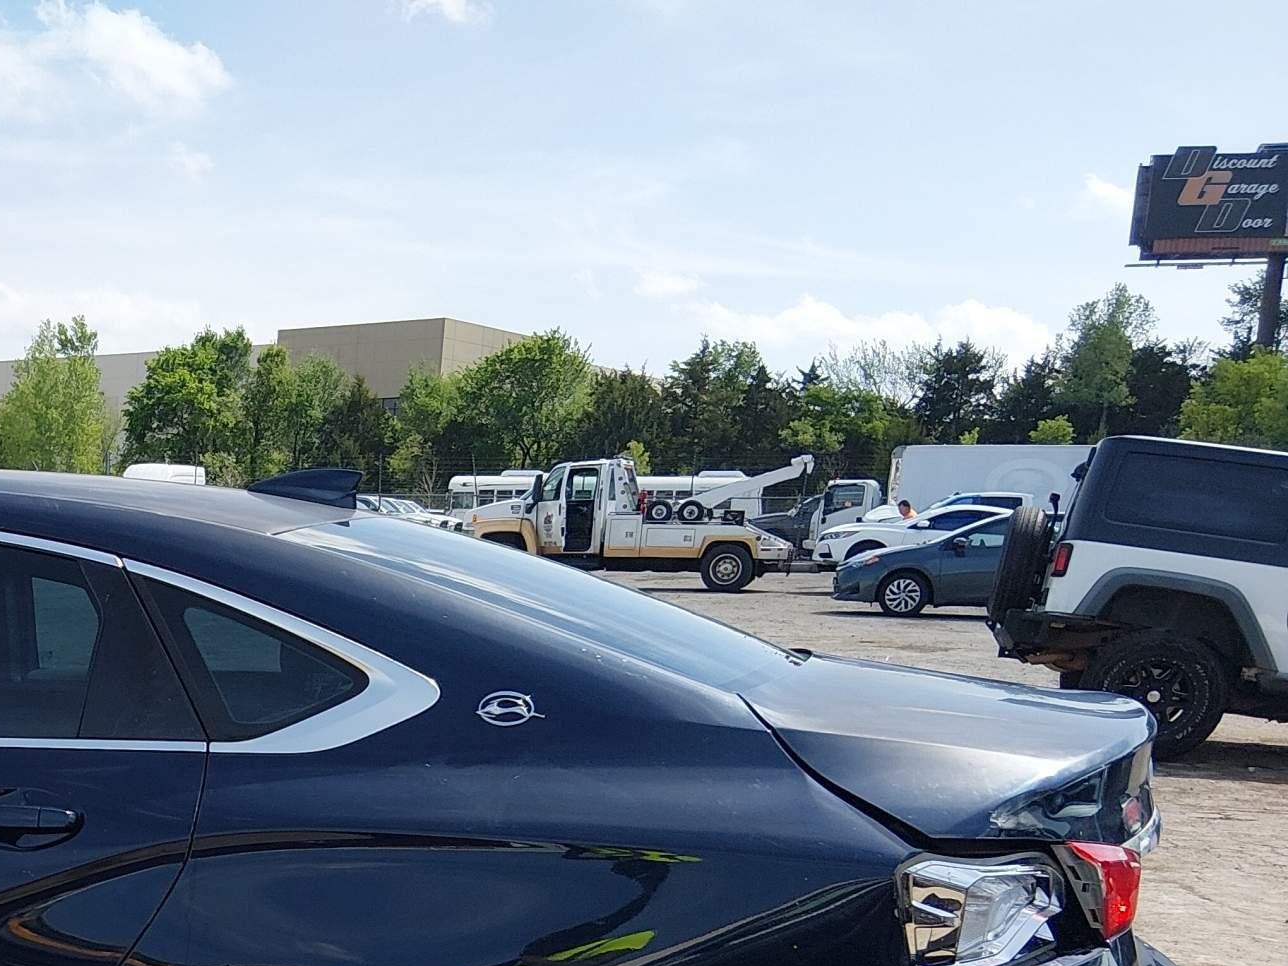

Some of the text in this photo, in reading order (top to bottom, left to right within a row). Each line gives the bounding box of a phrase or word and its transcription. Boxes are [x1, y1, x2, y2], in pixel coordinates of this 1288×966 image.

[1162, 146, 1280, 180] Discount
[1177, 170, 1280, 206] Garage
[1195, 197, 1274, 232] Door
